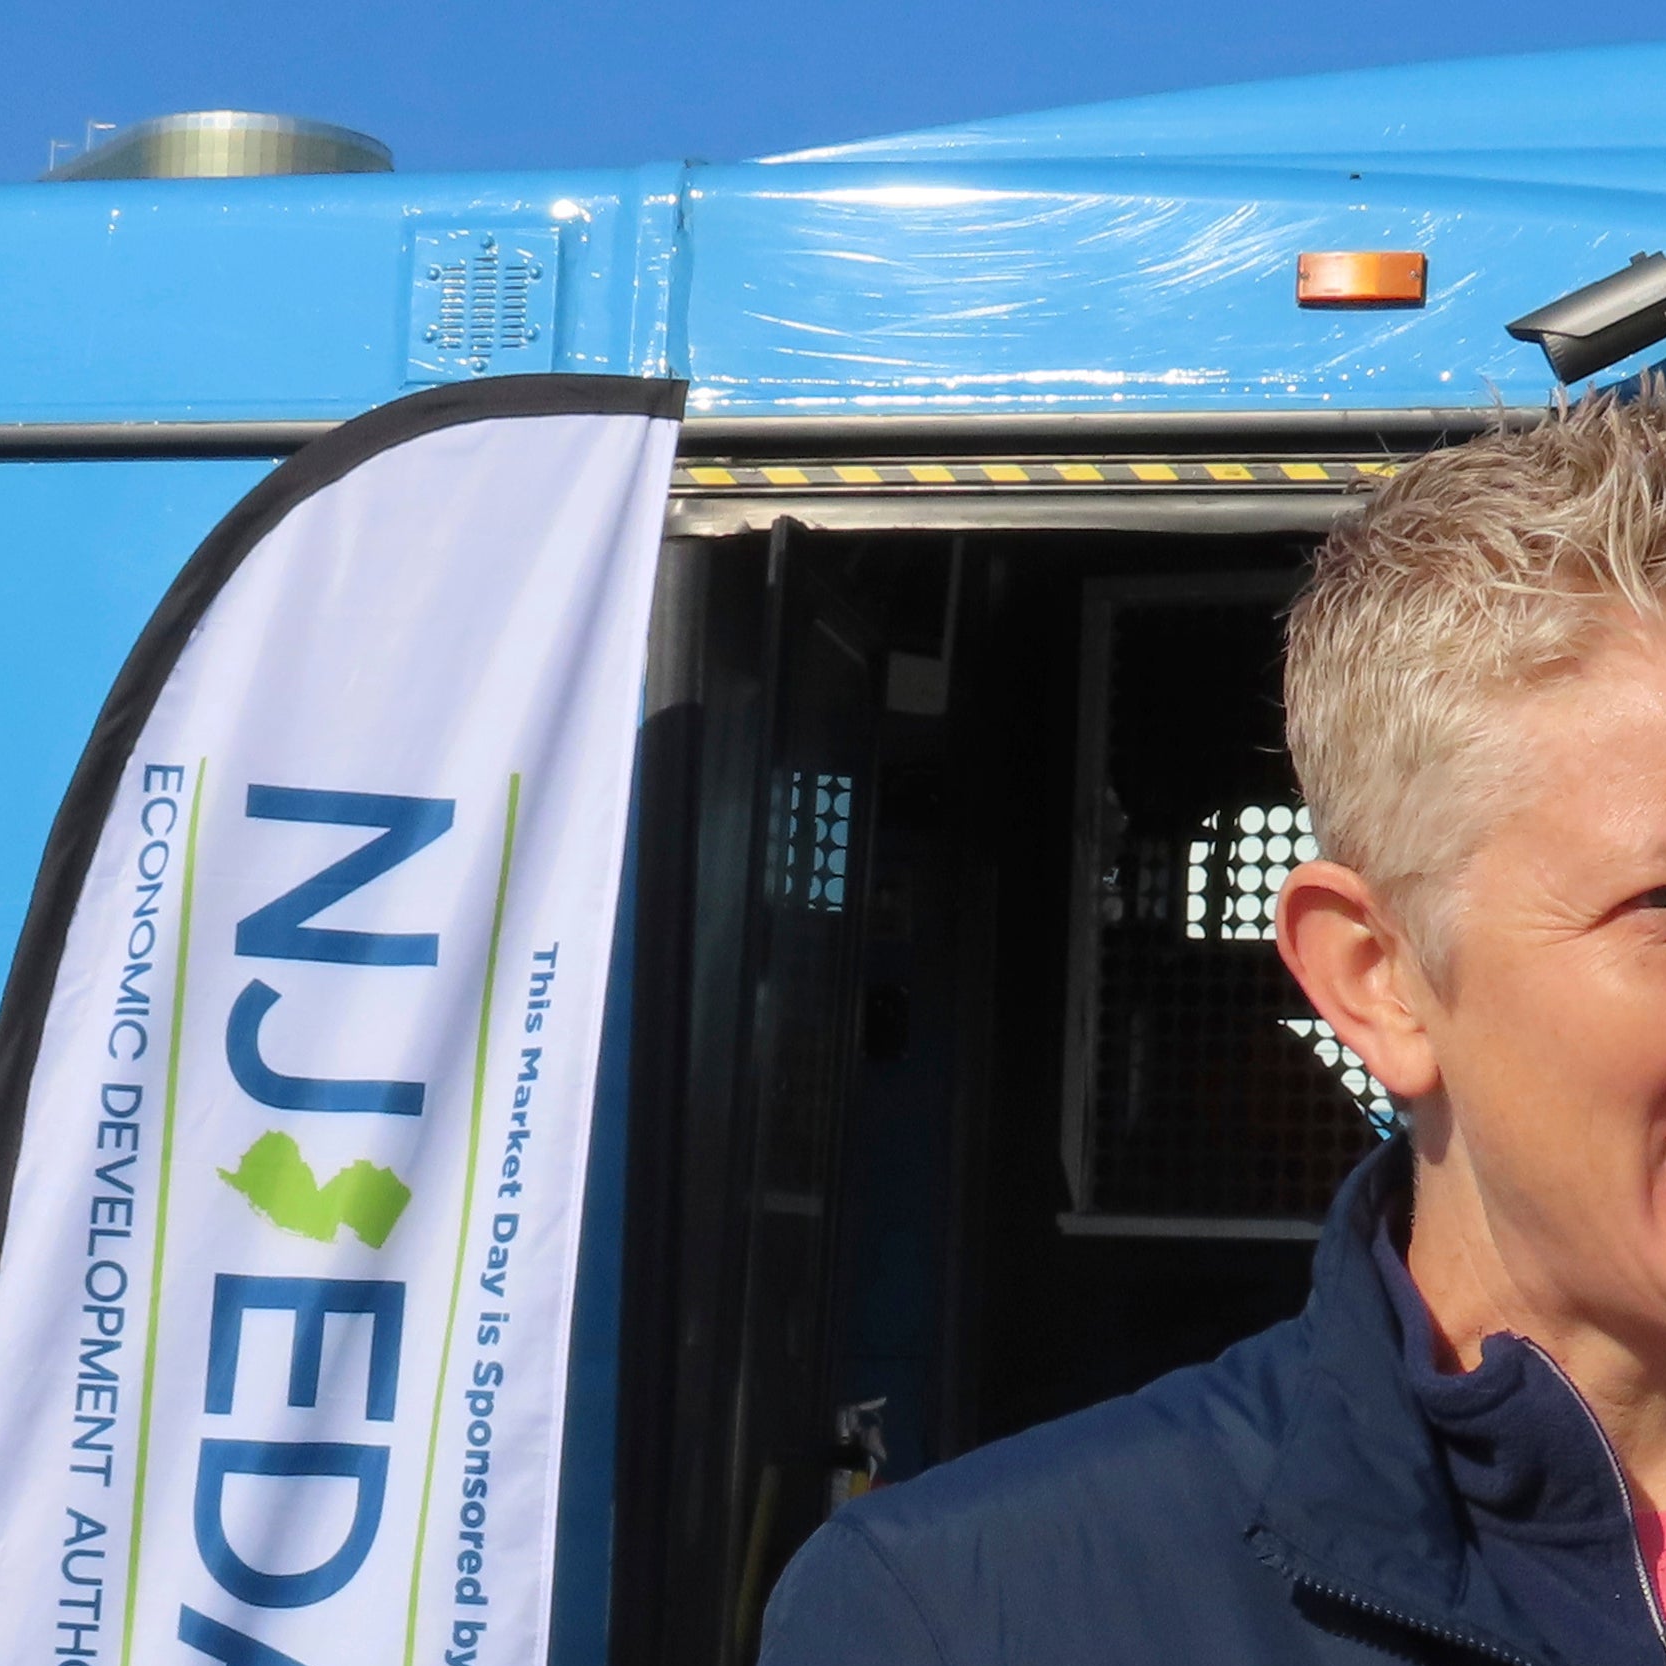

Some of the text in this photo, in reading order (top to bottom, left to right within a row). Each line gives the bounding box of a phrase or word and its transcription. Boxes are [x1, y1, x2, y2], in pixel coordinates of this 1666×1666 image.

[107, 761, 185, 1061] ECONOMIC
[525, 941, 559, 1034] This
[498, 1046, 544, 1201] Market
[68, 1083, 144, 1488] DEVELOPMENT
[476, 1311, 511, 1347] is
[480, 1213, 520, 1298] Day
[454, 1360, 504, 1607] Sponsored
